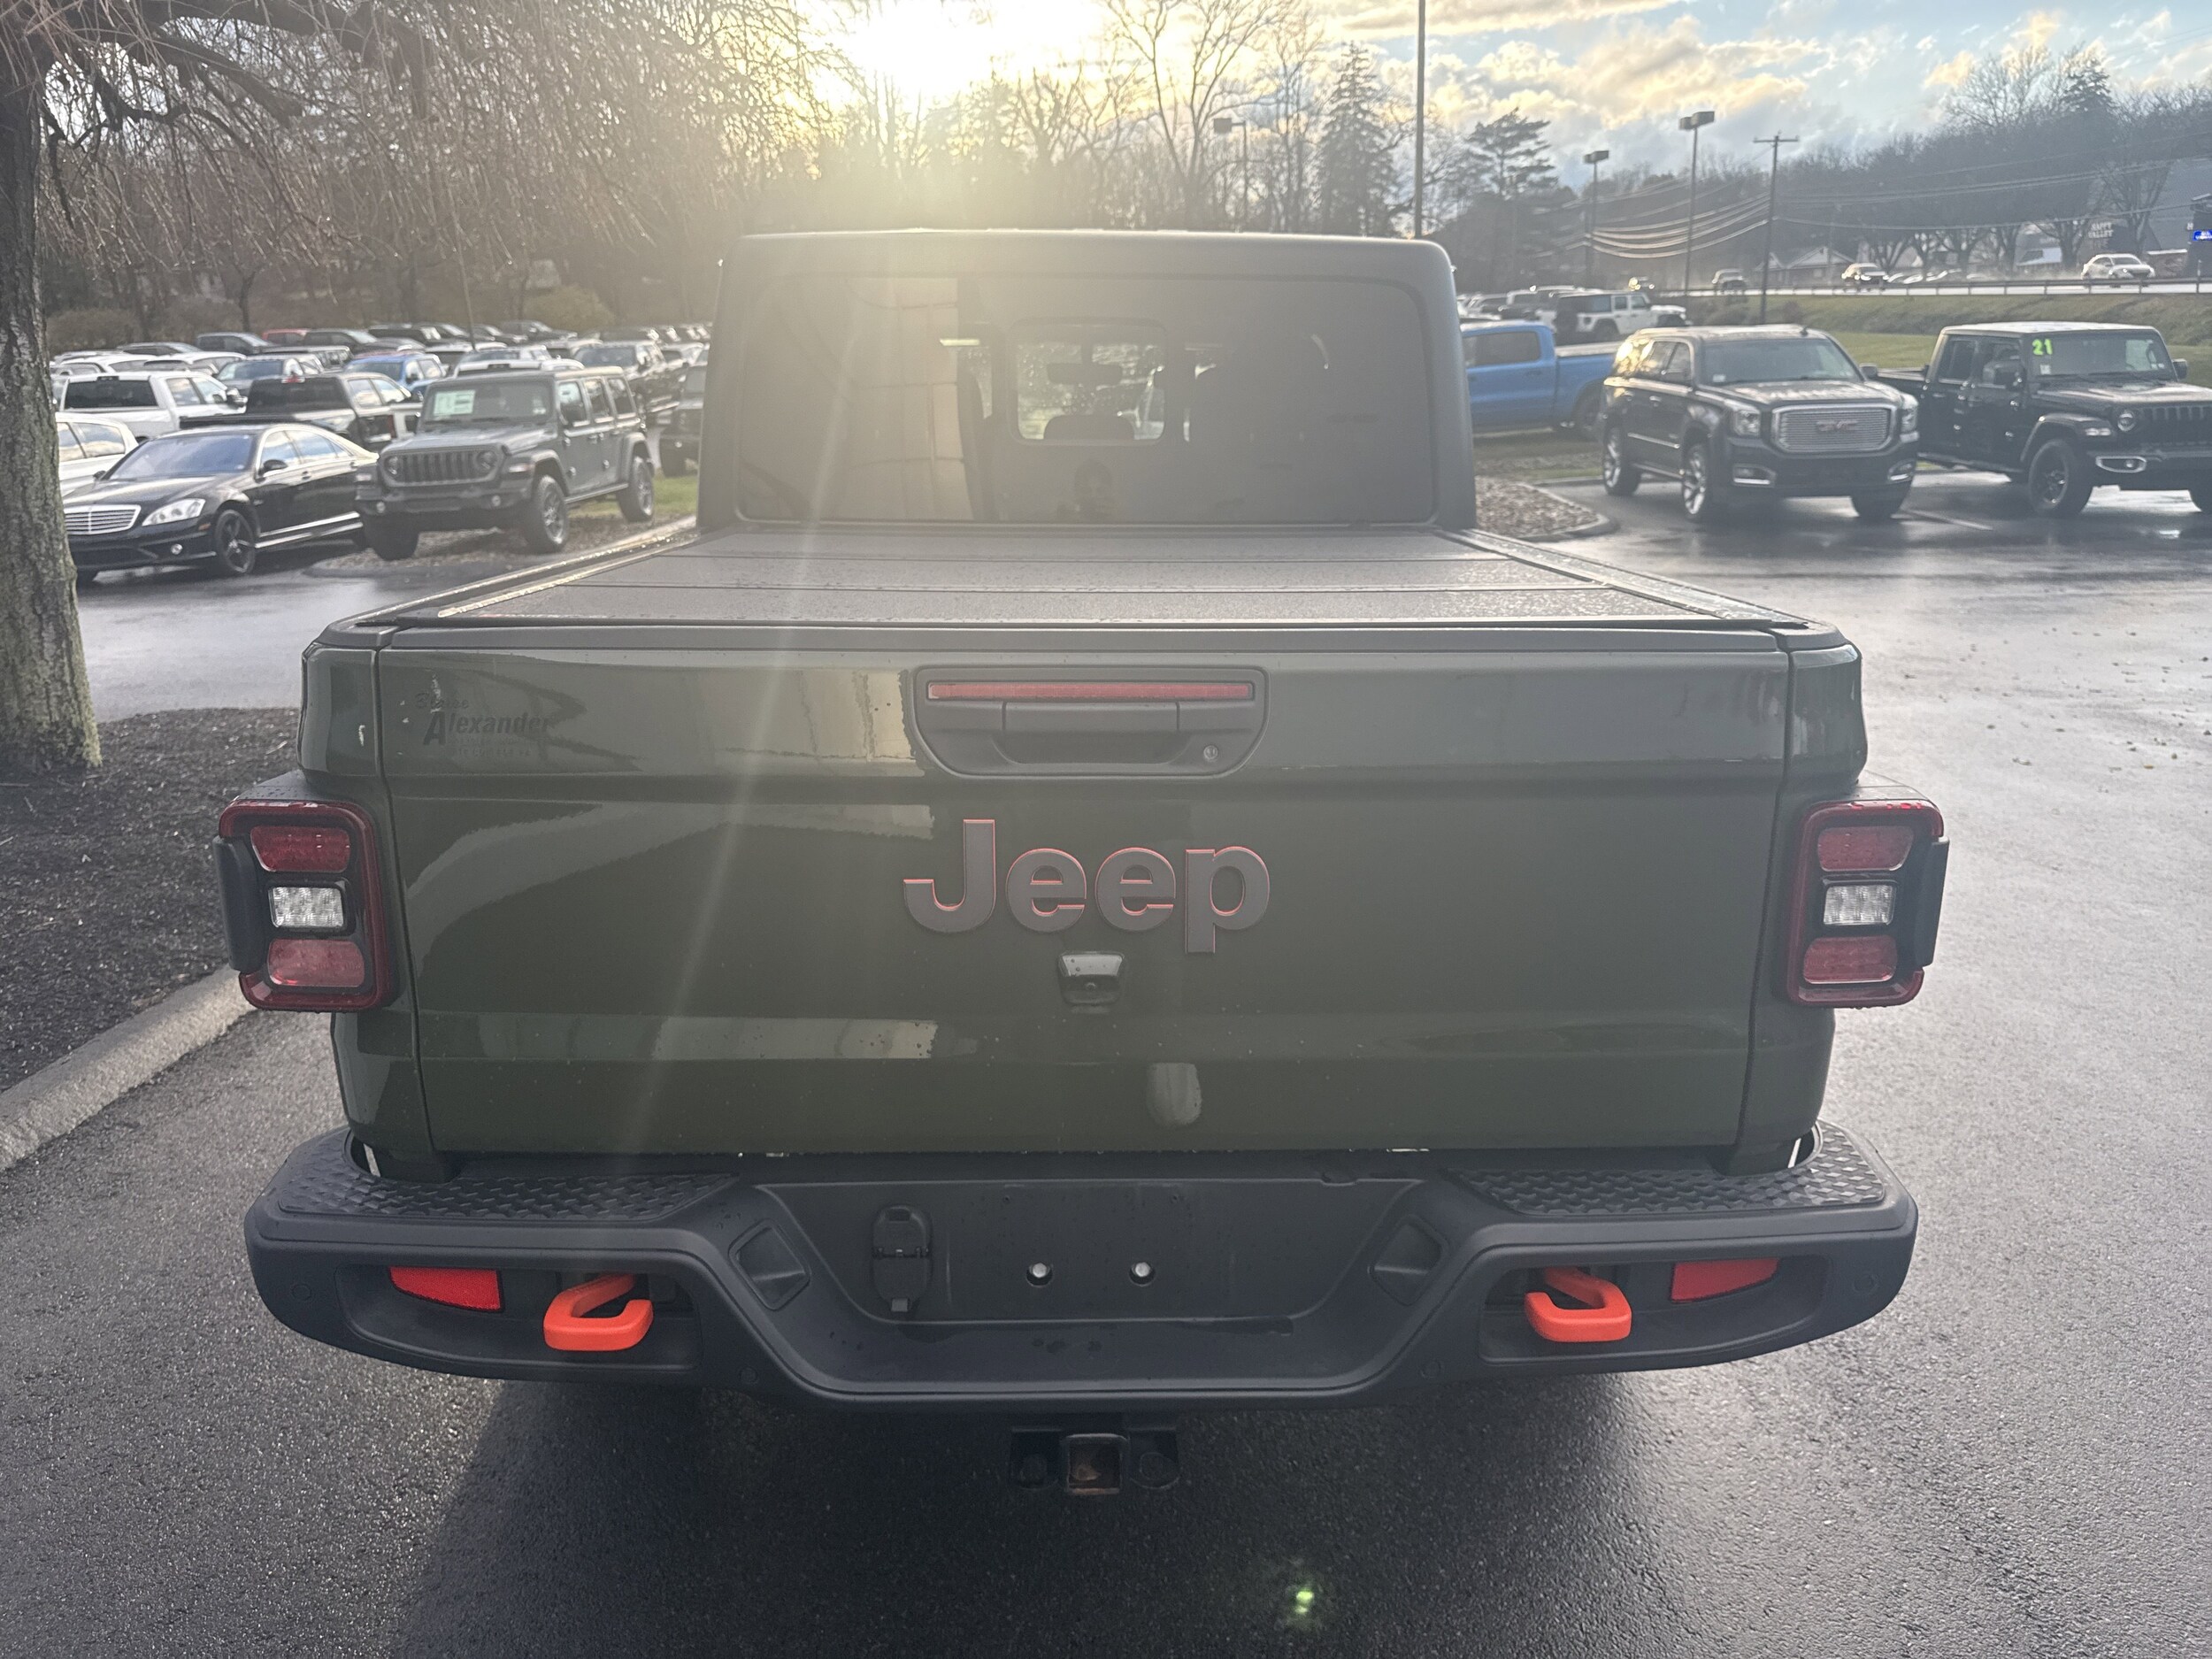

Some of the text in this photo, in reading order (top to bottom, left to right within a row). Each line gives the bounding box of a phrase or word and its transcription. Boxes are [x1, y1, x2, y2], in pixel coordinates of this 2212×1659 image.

[2032, 338, 2053, 356] 21
[1816, 420, 1859, 432] GMC
[423, 711, 553, 746] Alexander
[902, 818, 1271, 954] Jeep
